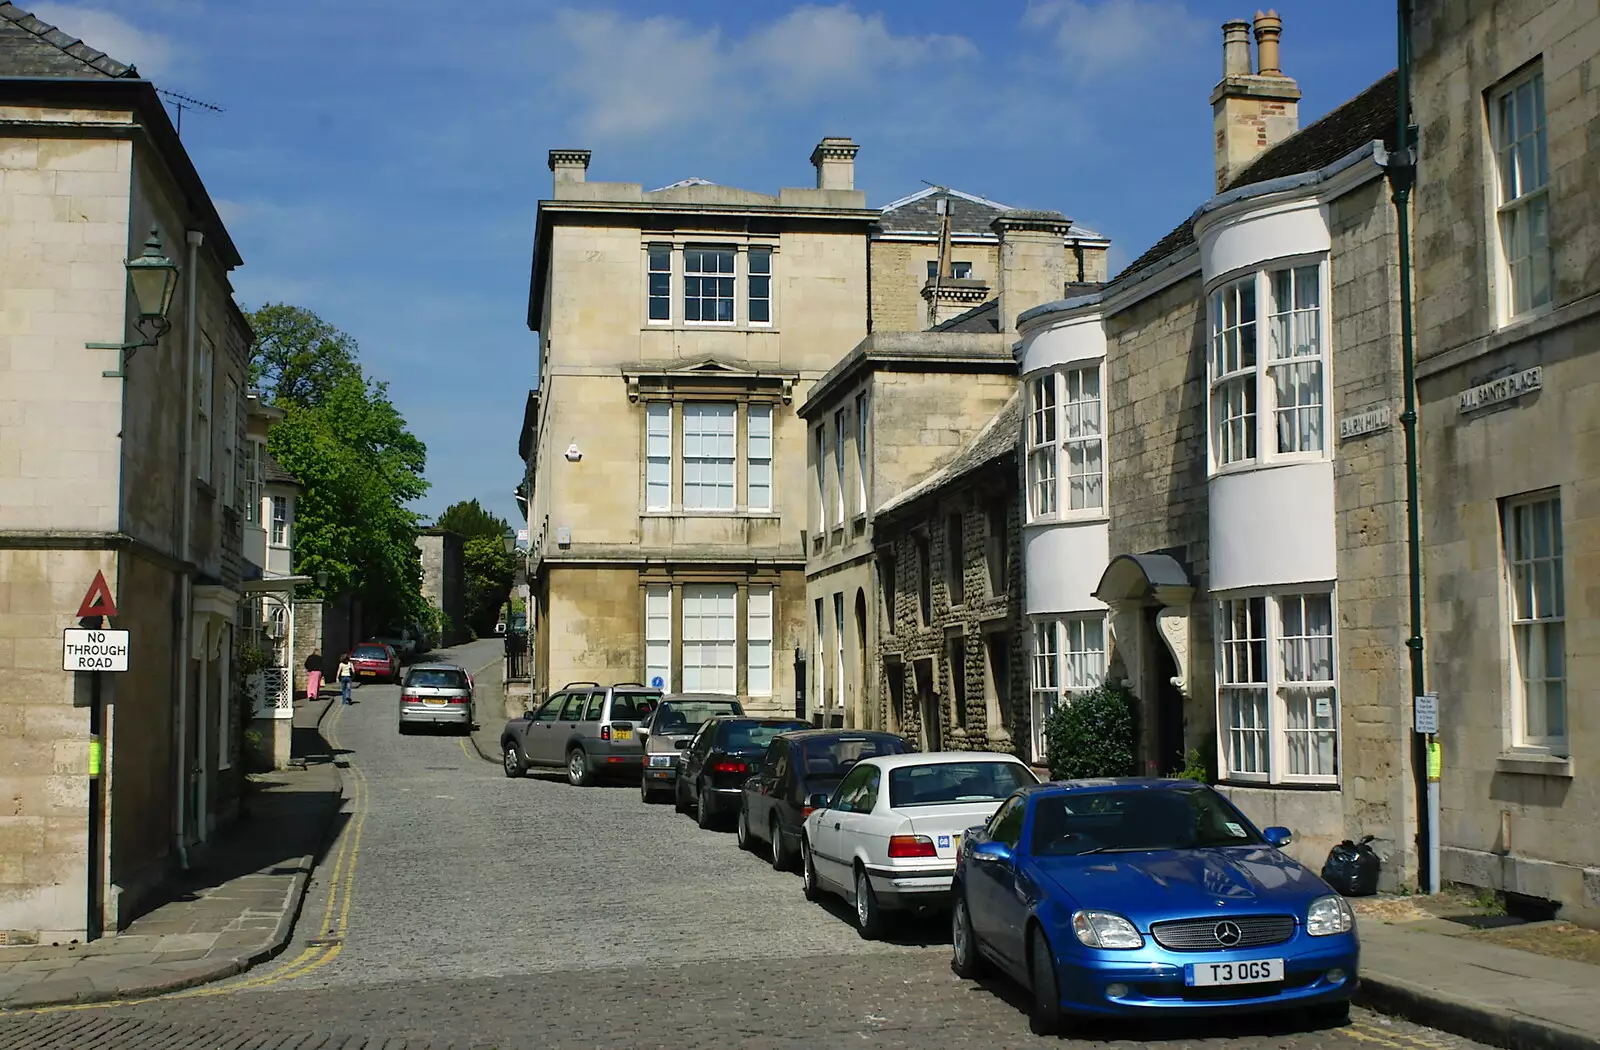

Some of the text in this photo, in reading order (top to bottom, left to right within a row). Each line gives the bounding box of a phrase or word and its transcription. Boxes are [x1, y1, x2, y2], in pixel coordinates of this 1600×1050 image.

[1460, 391, 1478, 411] ALL
[1509, 370, 1538, 397] PLACE
[1342, 410, 1388, 436] BARN HILL
[87, 632, 106, 643] NO
[66, 644, 126, 656] THROUGH
[78, 657, 113, 668] ROAD
[1210, 962, 1270, 981] T3 OGS
